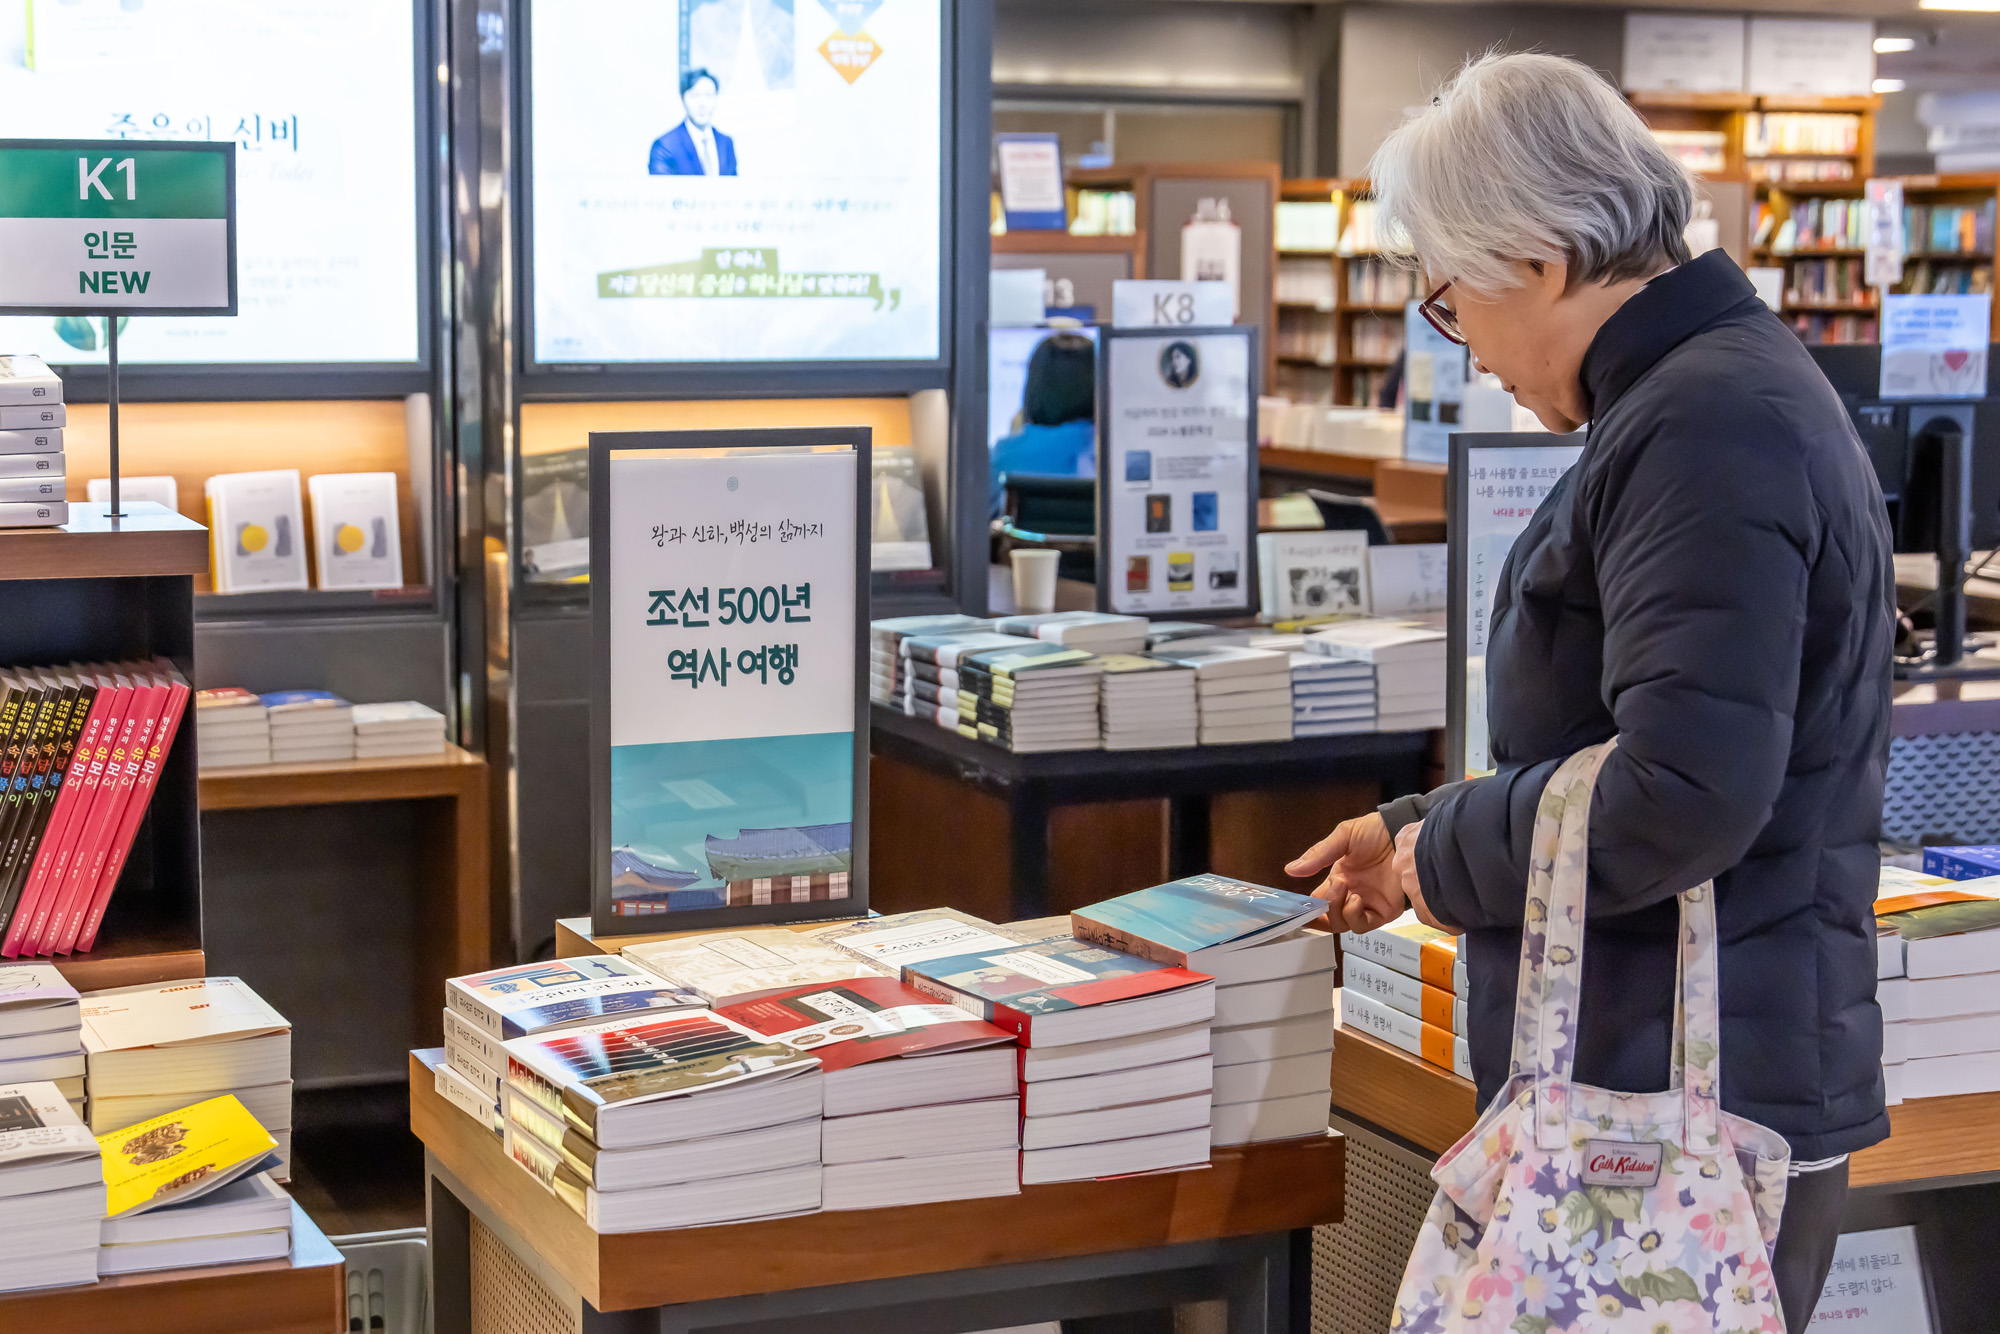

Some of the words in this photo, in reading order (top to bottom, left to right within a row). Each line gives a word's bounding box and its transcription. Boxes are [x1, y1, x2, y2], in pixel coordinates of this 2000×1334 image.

[232, 113, 297, 152] 신비
[78, 157, 136, 200] K1
[83, 230, 137, 260] 인문
[80, 271, 151, 294] NEW
[1153, 293, 1195, 325] K8
[1489, 467, 1516, 480] 사용할
[1518, 468, 1528, 479] 줄
[1531, 467, 1557, 479] 모르면
[1476, 486, 1494, 498] 나를
[1497, 486, 1524, 498] 사용할
[1526, 486, 1536, 497] 줄
[1493, 508, 1514, 518] 나다운
[650, 524, 687, 547] 왕과
[778, 518, 824, 543] 삶까지
[646, 586, 710, 628] 조선
[718, 582, 812, 625] 500년
[668, 647, 731, 688] 역사
[737, 643, 799, 687] 여행
[86, 719, 100, 744] 한국의
[104, 718, 117, 744] 한국의
[121, 719, 135, 744] 한국의
[140, 718, 154, 744] 한국의
[157, 717, 170, 742] 한국의
[9, 744, 38, 808] 속담풀이
[26, 742, 56, 806] 속담풀이
[44, 740, 74, 803] 속담풀이
[67, 748, 90, 791] 유모어
[85, 747, 107, 790] 유모어
[102, 748, 125, 791] 유모어
[121, 747, 144, 791] 유모어
[138, 745, 161, 788] 유모어
[1348, 933, 1354, 942] 나
[1357, 934, 1370, 950] 사용
[1372, 937, 1393, 957] 설명서
[1350, 968, 1357, 980] 나
[1359, 970, 1372, 988] 사용
[1374, 976, 1394, 995] 설명서
[1348, 1004, 1354, 1014] 나
[1357, 1006, 1370, 1024] 사용
[1372, 1014, 1392, 1033] 설명서
[1590, 1154, 1614, 1172] Cath
[1614, 1156, 1655, 1174] Kidston
[1858, 1254, 1902, 1271] 휘둘리고
[1838, 1280, 1869, 1296] 두렵지
[1872, 1278, 1897, 1294] 않다.
[1819, 1310, 1842, 1320] 하나의
[1846, 1306, 1868, 1319] 설명서
